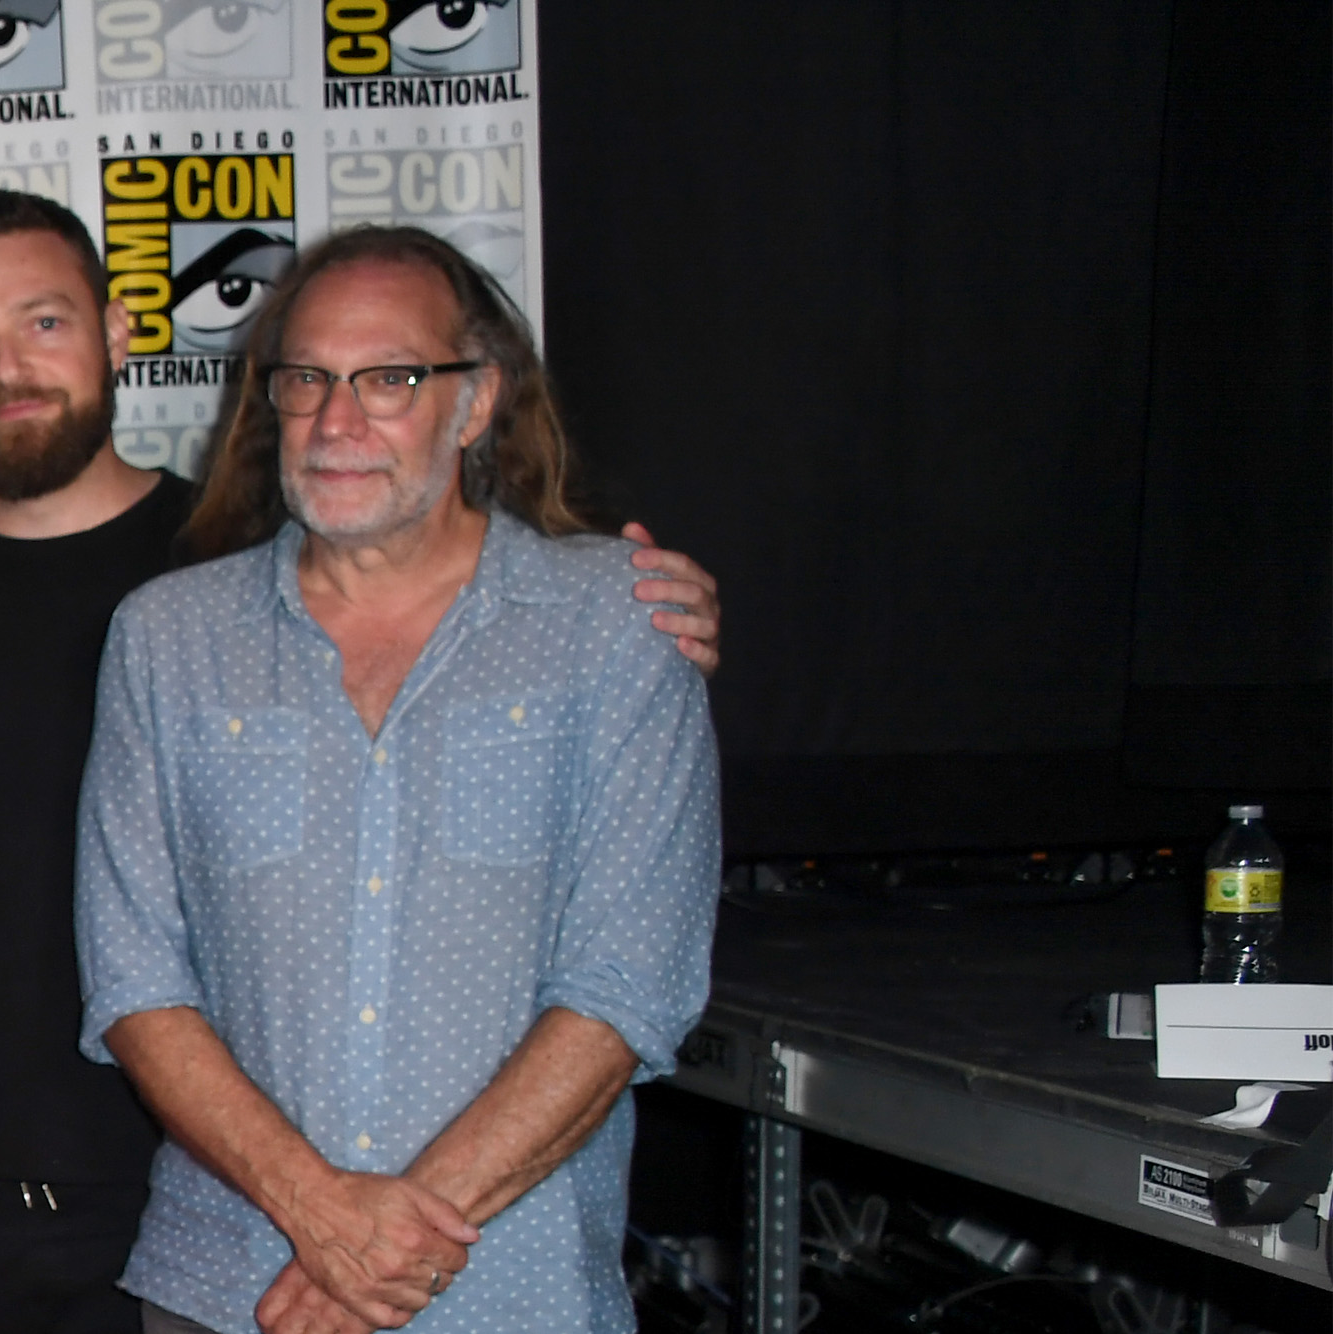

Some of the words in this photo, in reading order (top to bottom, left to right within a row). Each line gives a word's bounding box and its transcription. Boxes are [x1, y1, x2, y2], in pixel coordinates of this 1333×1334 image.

[97, 132, 161, 153] SAN
[191, 130, 294, 150] DIEGO
[416, 121, 523, 144] DIEGO
[173, 155, 294, 220] CON
[398, 147, 523, 214] CON
[1163, 1168, 1183, 1188] 2100
